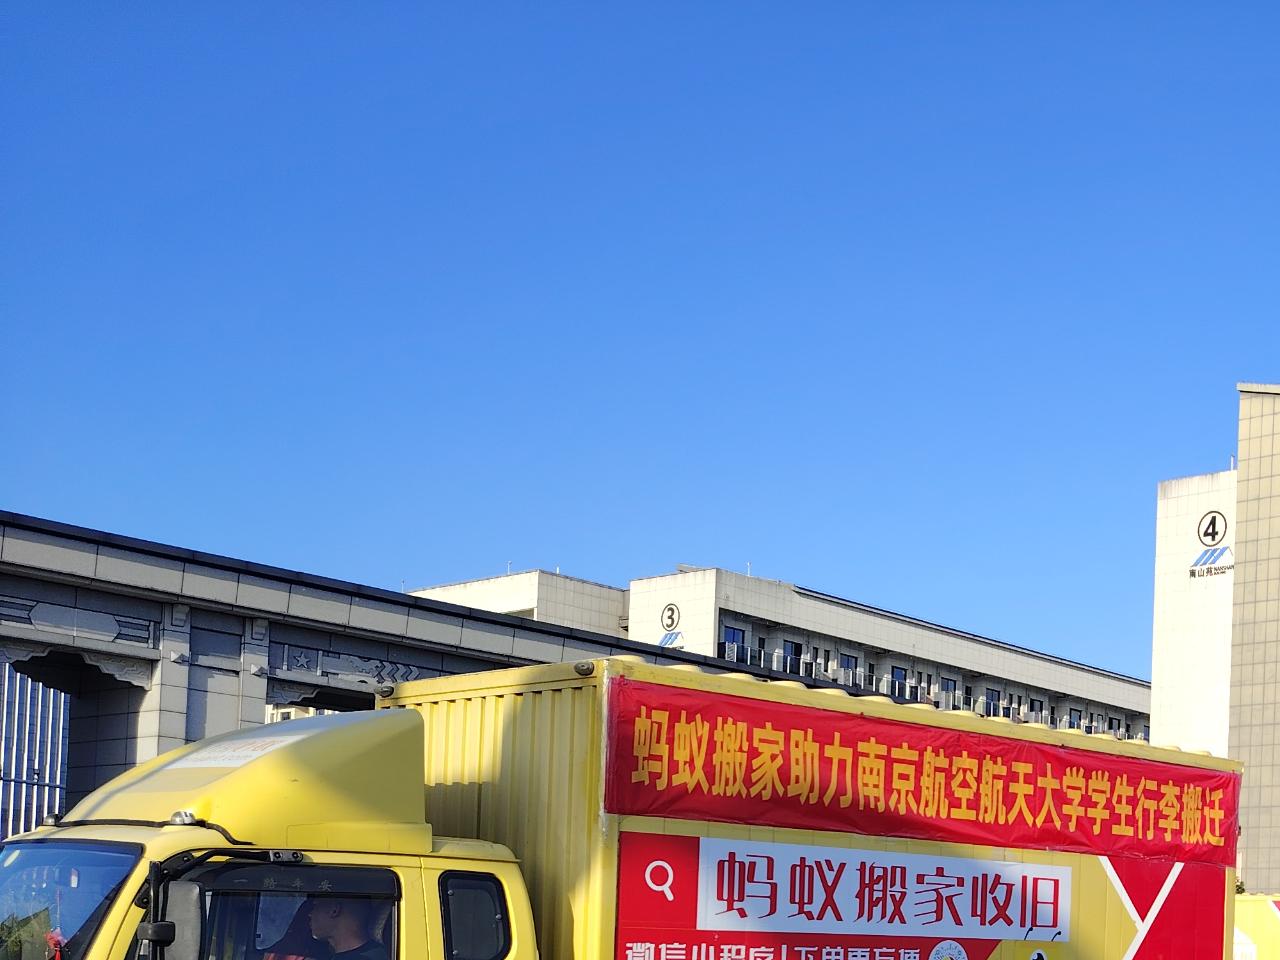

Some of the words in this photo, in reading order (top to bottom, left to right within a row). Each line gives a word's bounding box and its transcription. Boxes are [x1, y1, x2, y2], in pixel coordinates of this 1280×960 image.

[631, 704, 1226, 847] 蚂蚁搬家助力南京航空航天大学学生行李搬迁
[714, 851, 1062, 929] 蚂蚁搬家收旧
